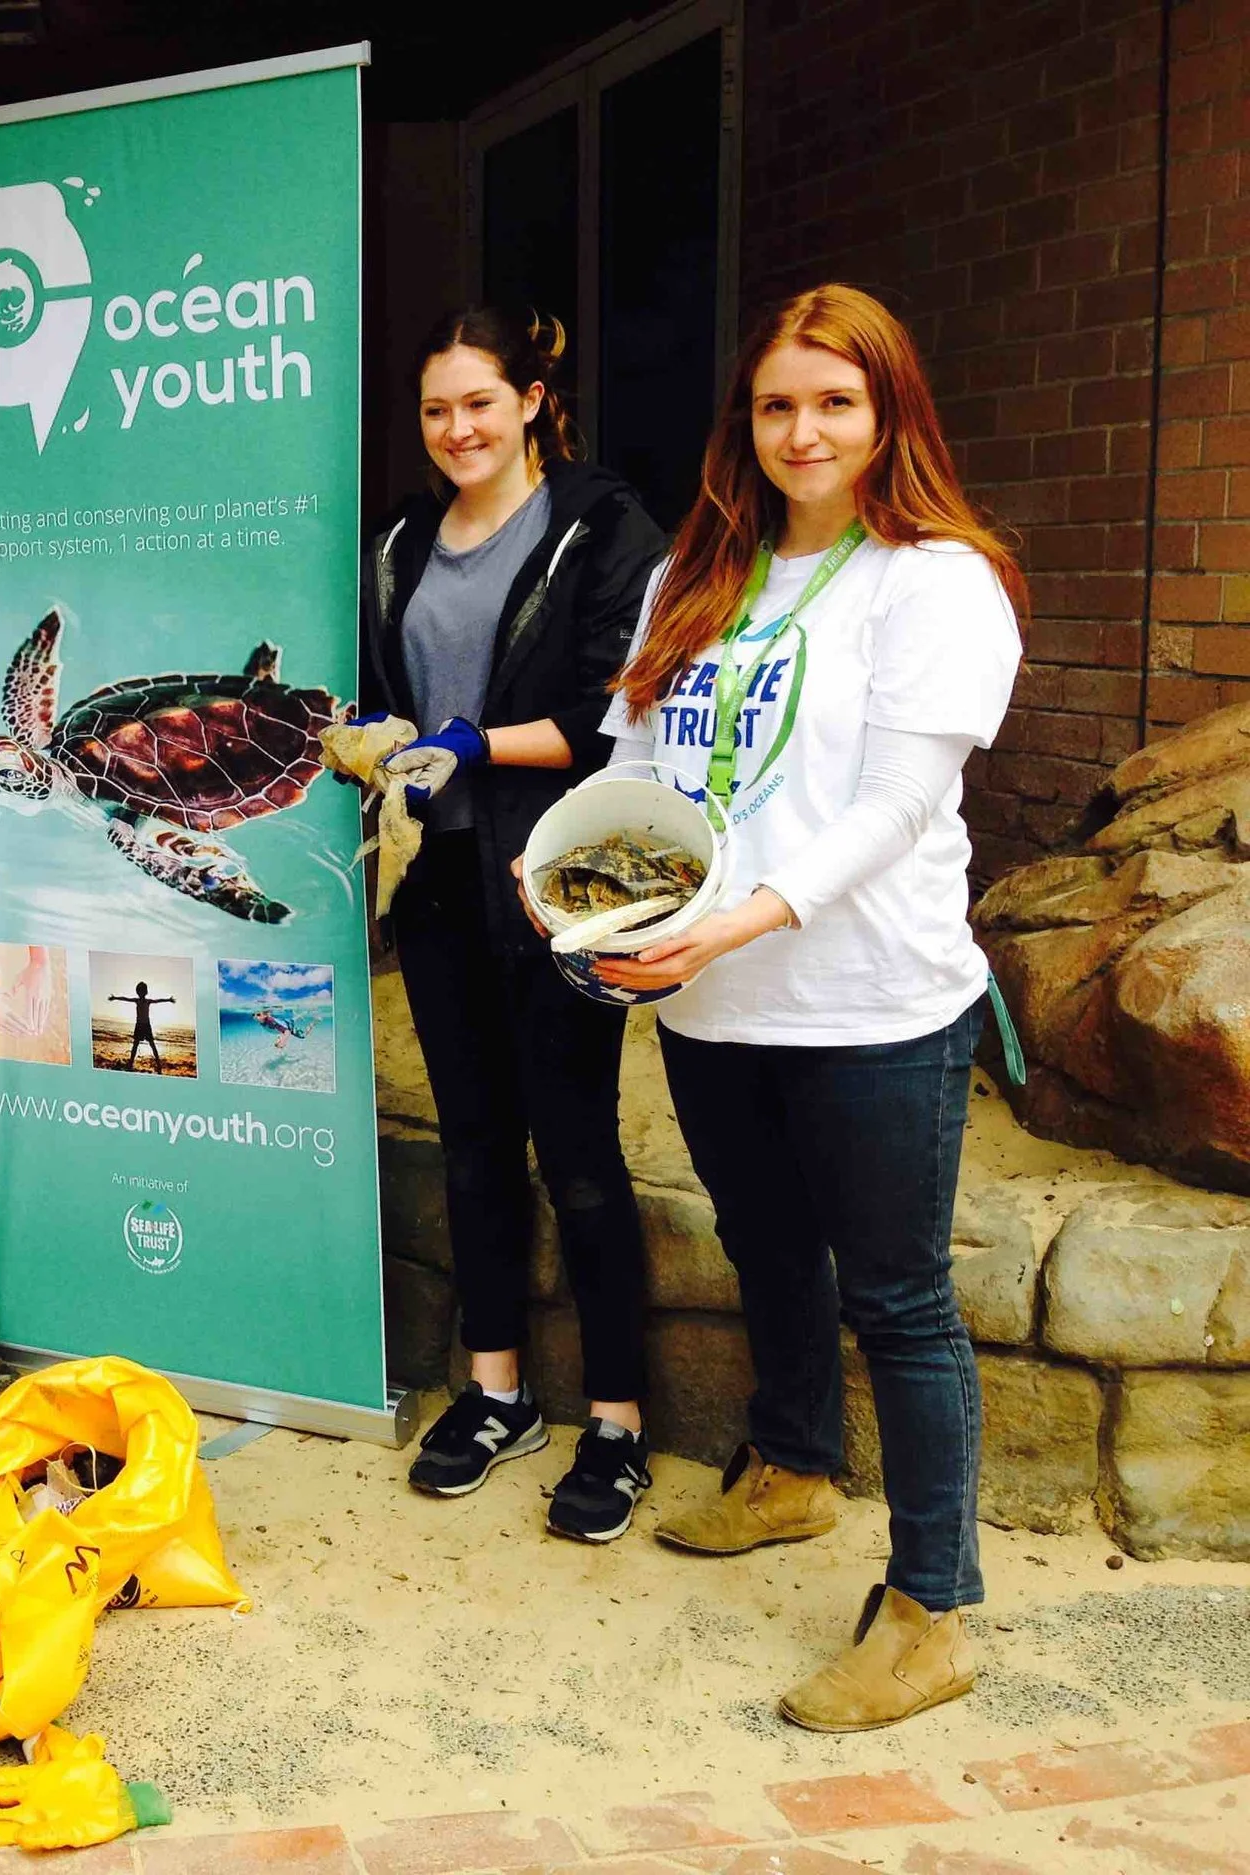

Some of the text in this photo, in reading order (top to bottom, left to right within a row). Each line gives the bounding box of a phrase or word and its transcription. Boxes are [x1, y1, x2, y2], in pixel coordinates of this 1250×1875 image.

[110, 335, 313, 430] youth
[36, 507, 69, 528] and
[73, 503, 170, 528] conserving
[175, 504, 210, 521] our
[214, 496, 289, 521] planet's
[294, 494, 320, 515] #1
[48, 535, 114, 558] system,
[134, 532, 191, 552] action
[196, 532, 215, 549] at
[220, 535, 232, 547] a
[236, 526, 285, 547] time.
[749, 772, 785, 814] OCEANS
[111, 1172, 189, 1193] An initiative of
[136, 1234, 171, 1251] TRUST
